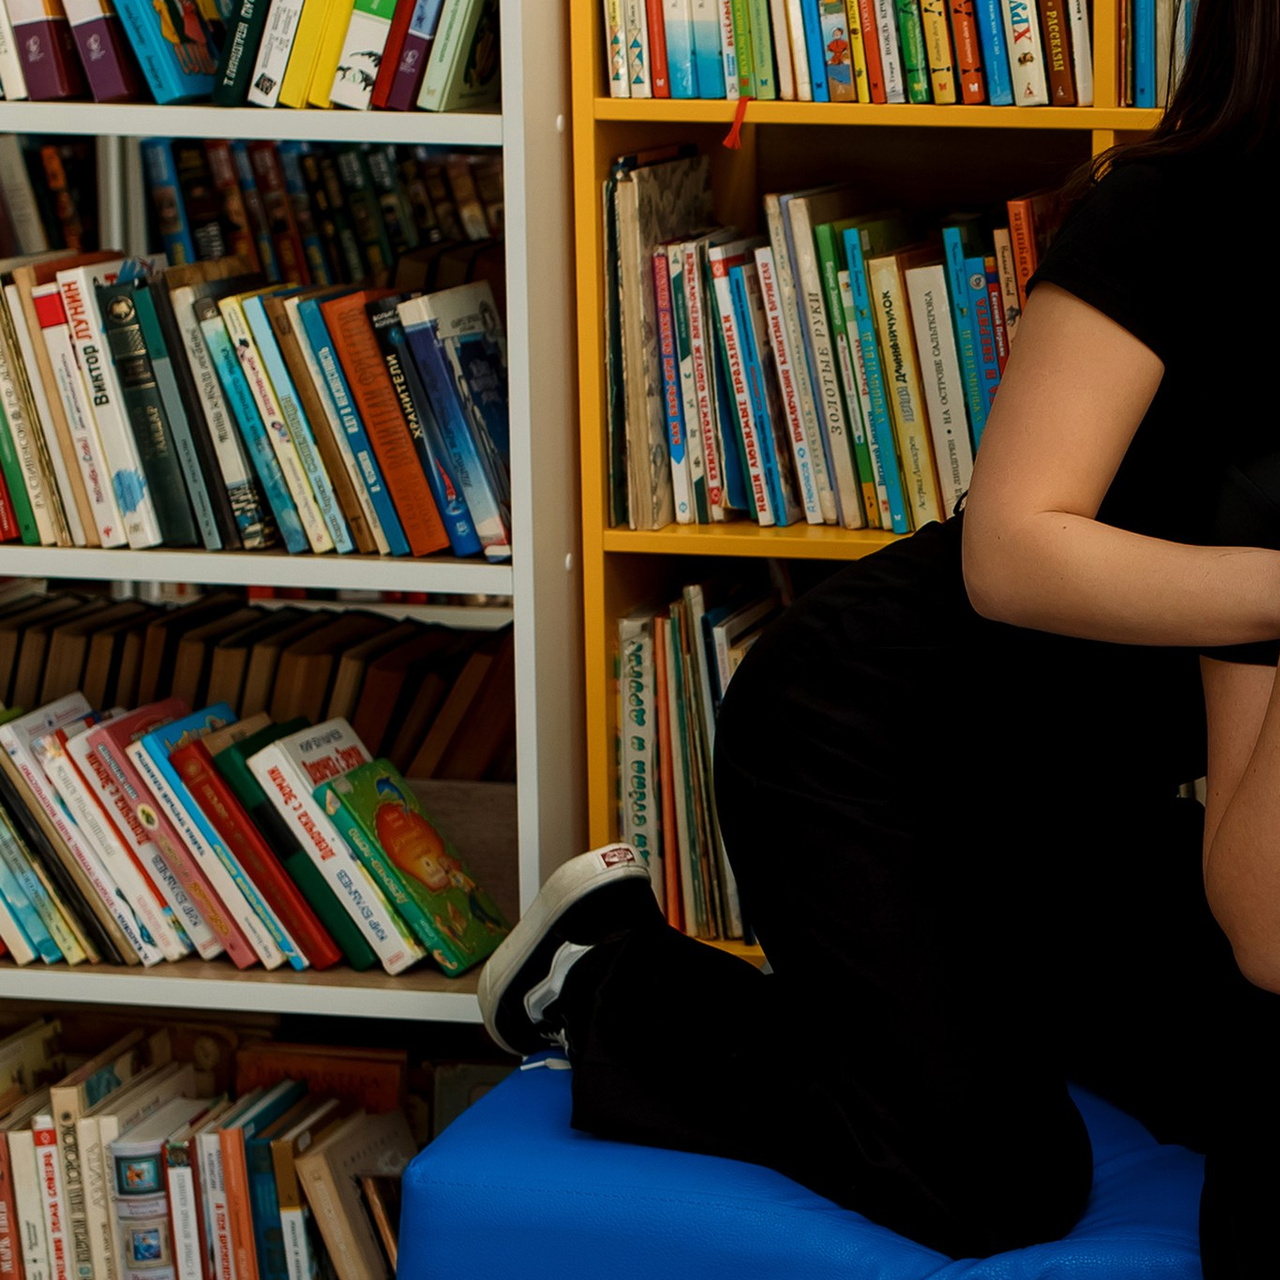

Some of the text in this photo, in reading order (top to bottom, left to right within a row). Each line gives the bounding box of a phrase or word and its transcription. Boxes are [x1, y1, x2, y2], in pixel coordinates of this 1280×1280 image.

[1046, 10, 1064, 72] РАССКАЗЫ
[61, 280, 93, 341] ЛУНИН
[386, 354, 423, 439] ХРАНИТЕЛИ
[808, 291, 842, 436] ЗОЛОТЫЕ РУКИ
